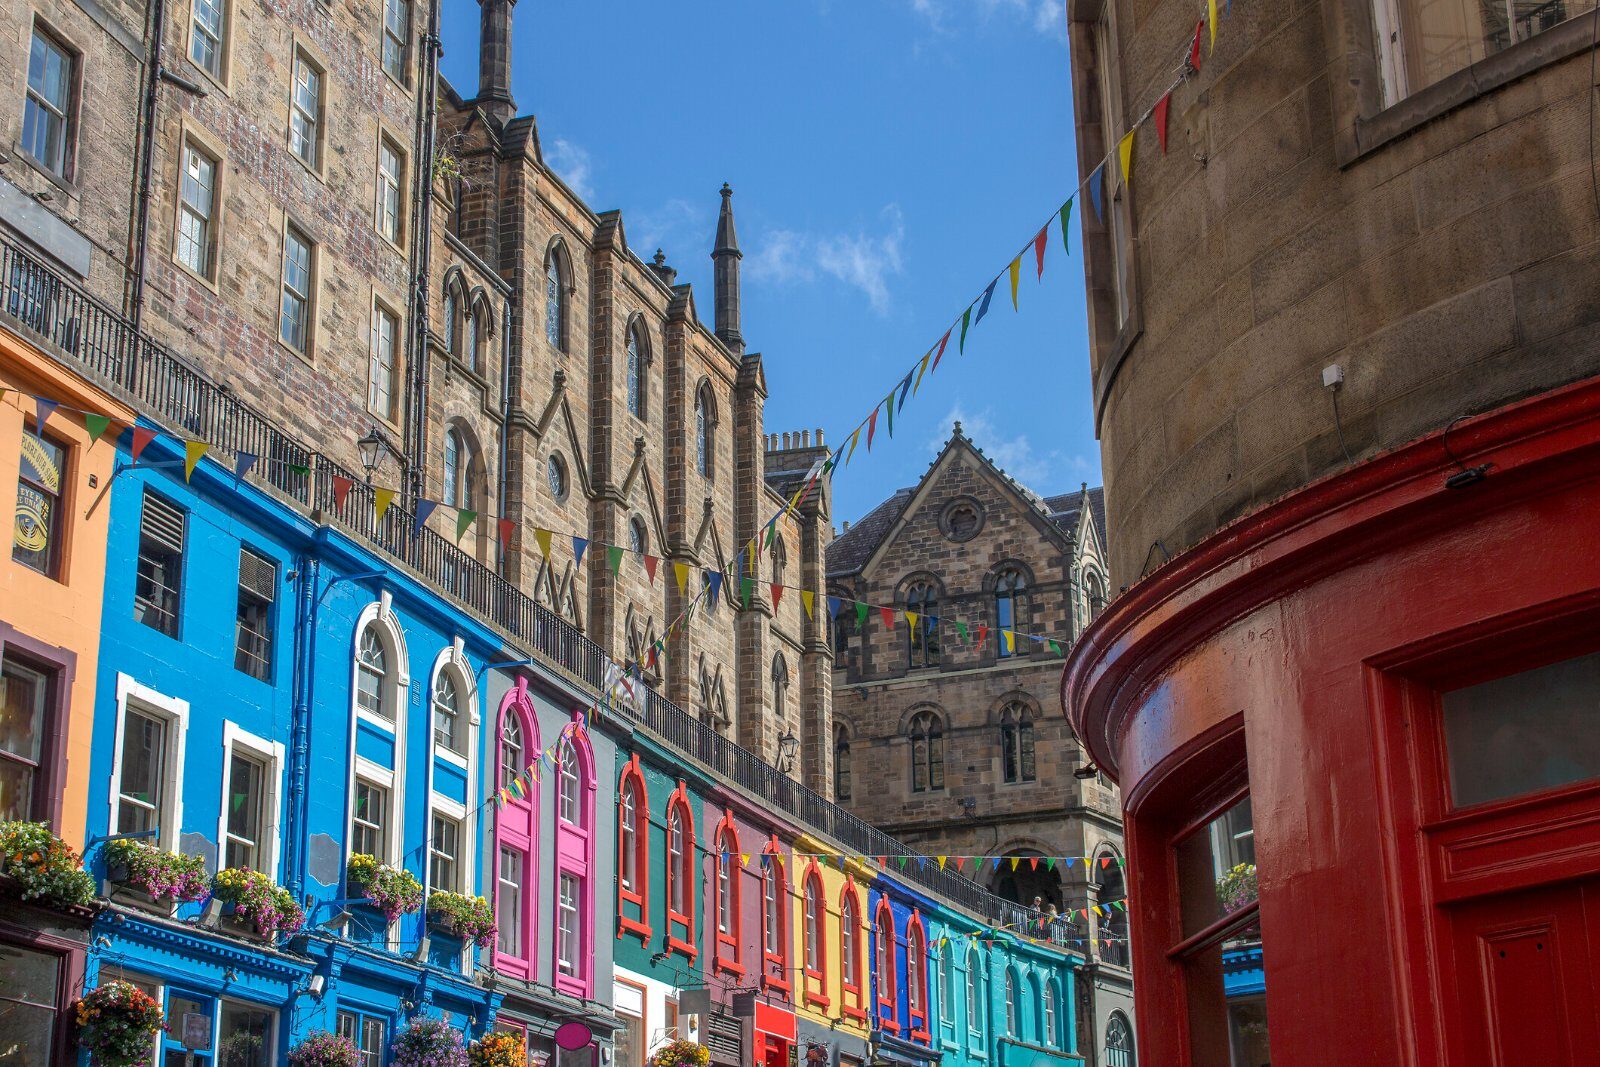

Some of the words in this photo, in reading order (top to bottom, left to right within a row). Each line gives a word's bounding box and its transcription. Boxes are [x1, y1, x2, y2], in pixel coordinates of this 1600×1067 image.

[36, 453, 47, 472] OUR
[45, 467, 57, 488] SHOP
[20, 487, 34, 498] EYE
[35, 494, 49, 512] FOR
[24, 497, 48, 520] UNIQUE
